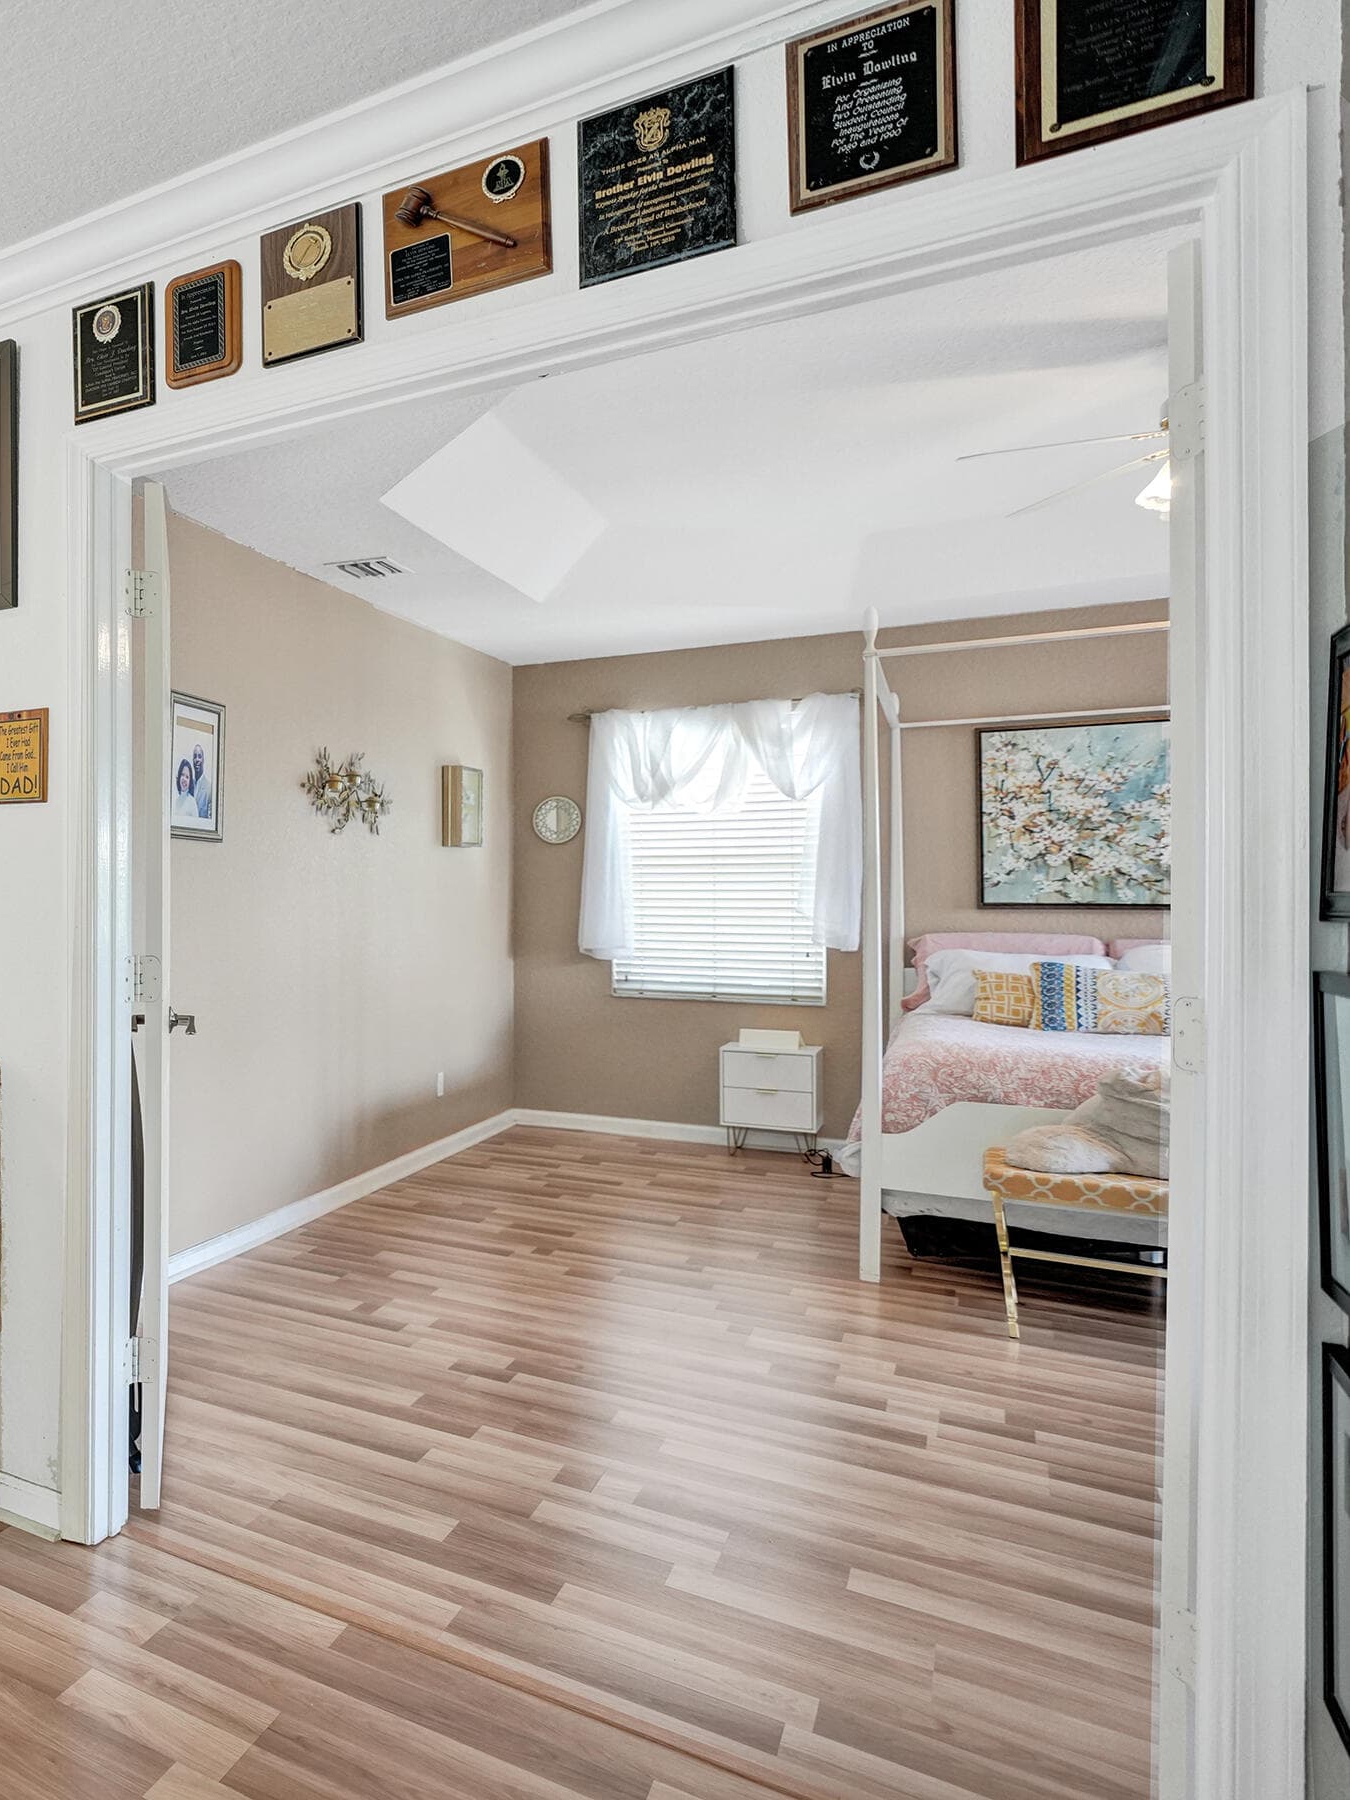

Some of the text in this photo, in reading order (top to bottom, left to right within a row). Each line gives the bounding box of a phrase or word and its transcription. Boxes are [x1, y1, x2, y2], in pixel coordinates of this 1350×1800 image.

[827, 17, 910, 53] IN APPRECIATION
[862, 40, 874, 51] TO
[822, 52, 918, 90] Elvin Dowling
[835, 77, 902, 104] For Organizing
[835, 86, 903, 112] And Presenting
[832, 93, 907, 122] Two Outstanding
[834, 102, 905, 130] Student Council
[831, 116, 909, 148] For The Years Of
[860, 136, 878, 147] and
[602, 137, 705, 174] THERE GOES AN ALPHA MAN
[595, 154, 713, 199] Brother Elvin Dowling
[0, 725, 7, 736] The
[8, 724, 28, 736] Greatest
[10, 737, 20, 748] Ever
[21, 738, 30, 747] Had
[0, 751, 11, 761] Came
[12, 750, 24, 760] From
[10, 762, 18, 772] Call
[20, 764, 28, 772] Him
[0, 775, 37, 795] DAD!
